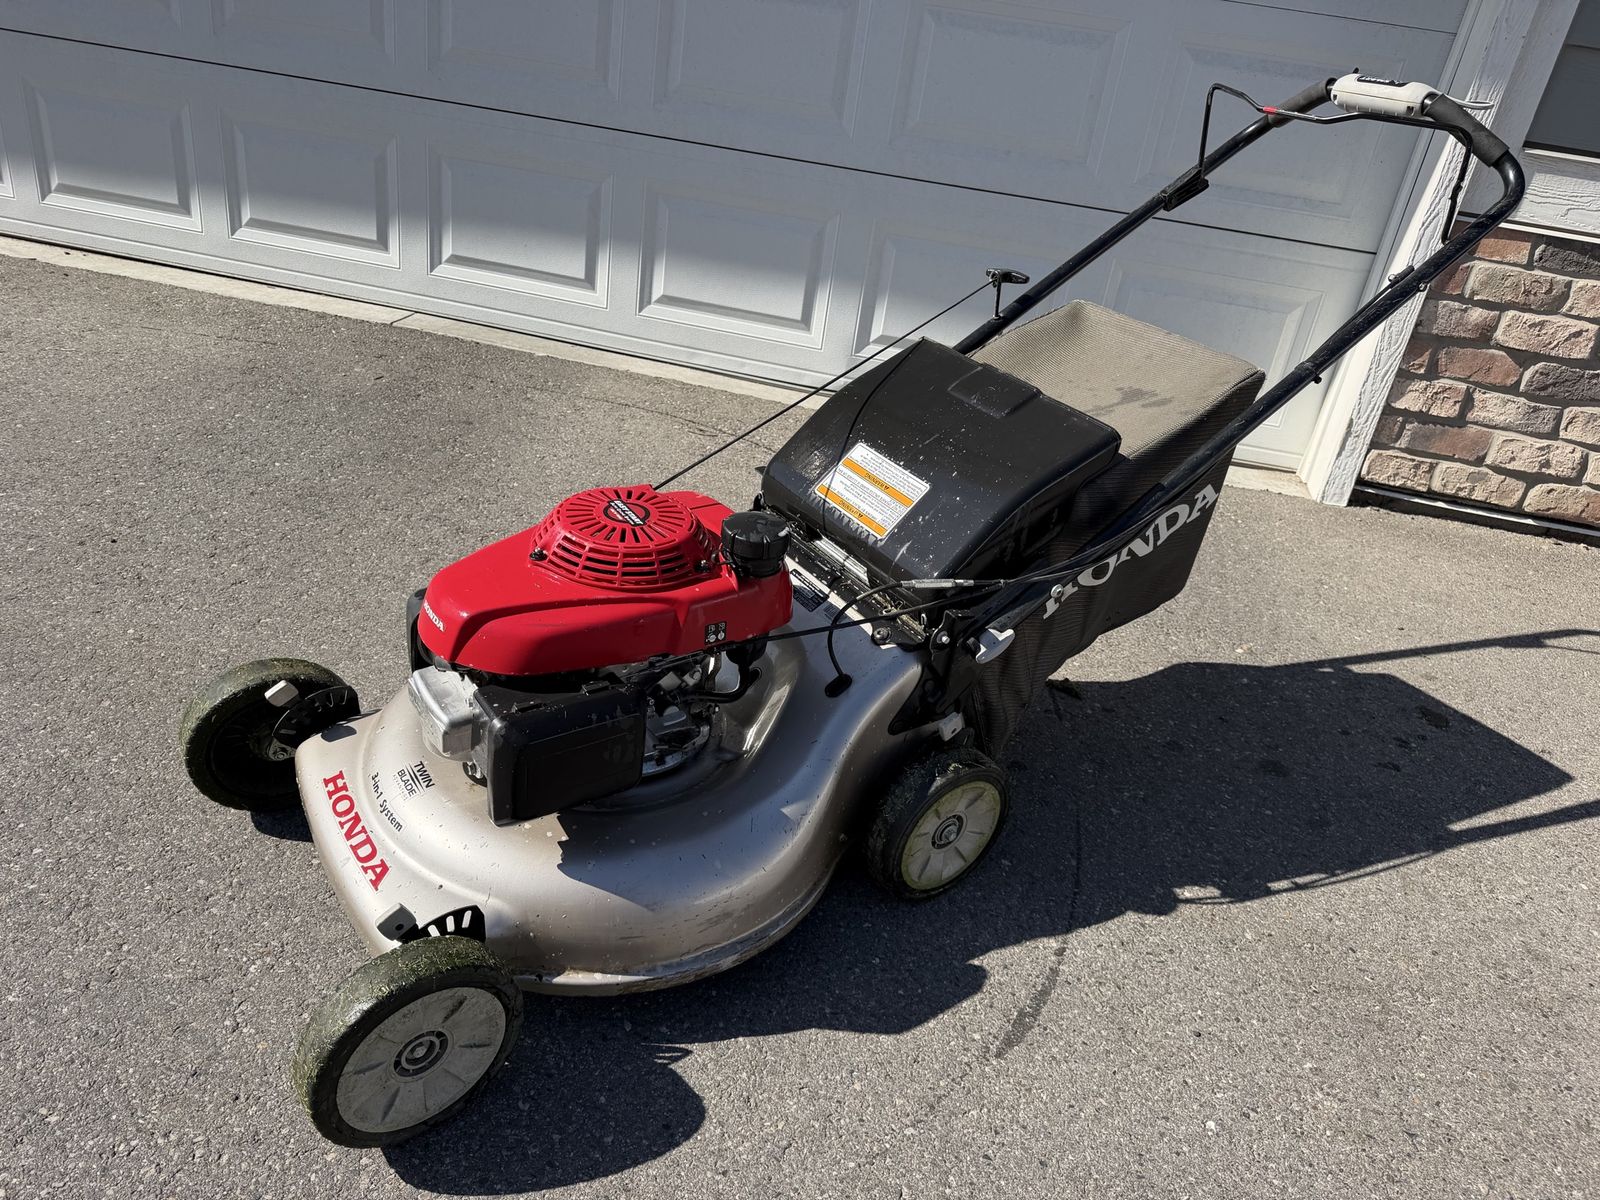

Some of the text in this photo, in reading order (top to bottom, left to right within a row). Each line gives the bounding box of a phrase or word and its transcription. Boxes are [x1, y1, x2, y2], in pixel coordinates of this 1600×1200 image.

[863, 472, 885, 488] WARNING
[397, 768, 417, 797] BLADE
[414, 760, 436, 789] TWIN
[379, 799, 403, 832] System
[322, 770, 390, 892] HONDA
